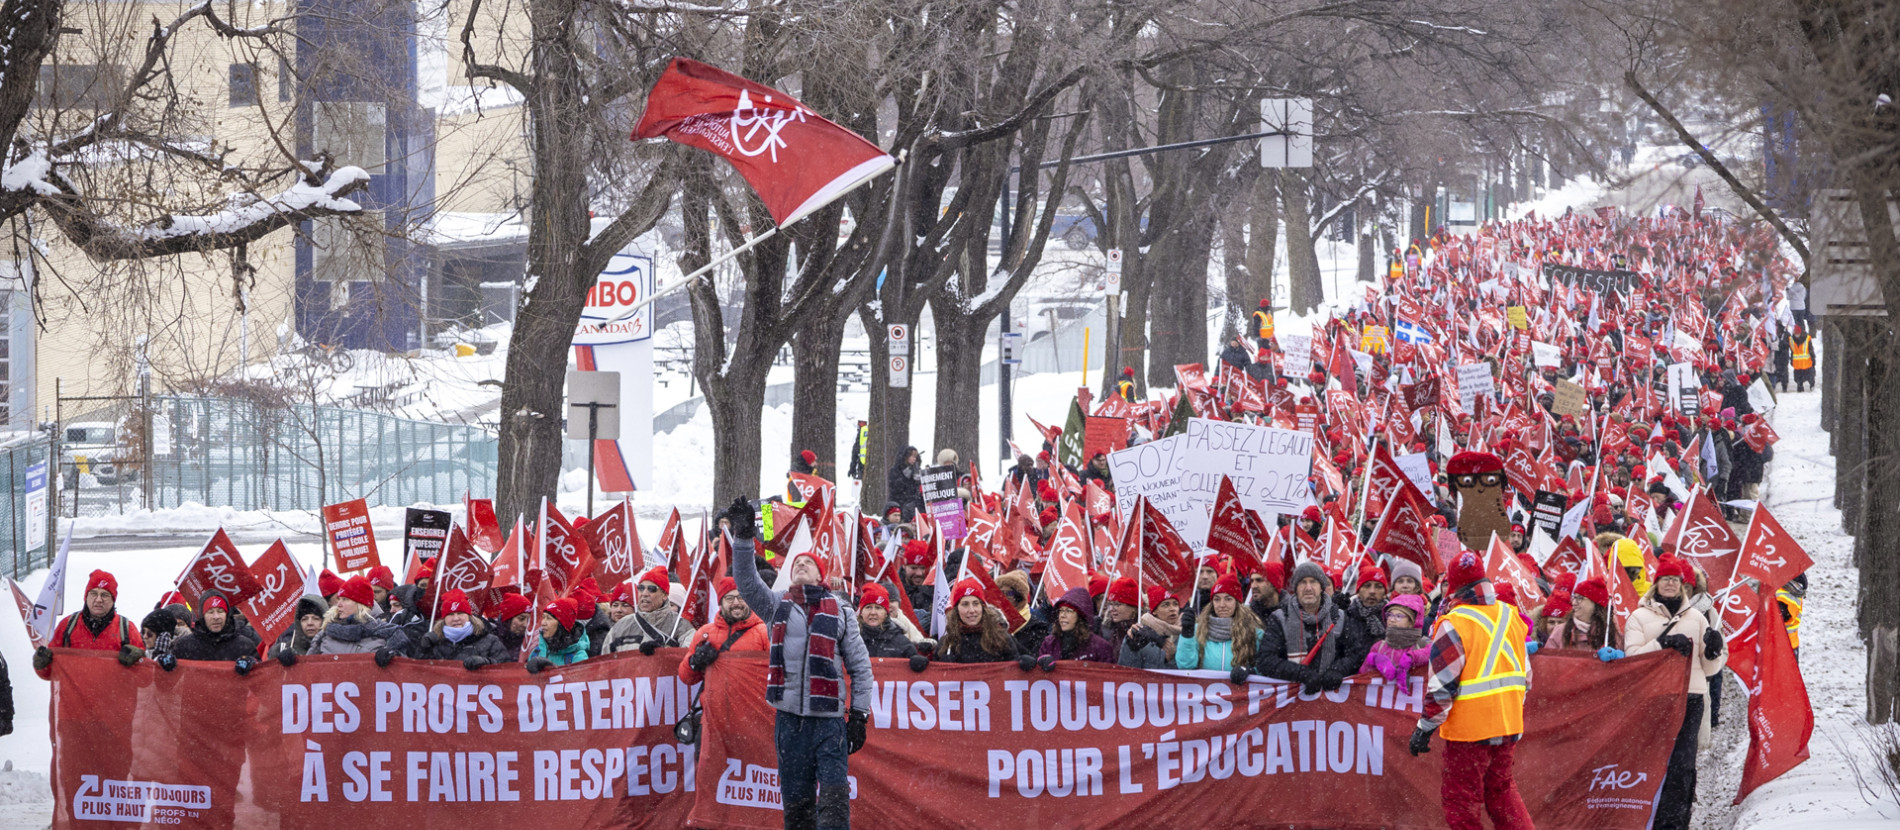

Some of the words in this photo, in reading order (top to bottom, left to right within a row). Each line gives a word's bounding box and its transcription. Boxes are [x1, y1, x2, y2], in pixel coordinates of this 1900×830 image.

[1187, 420, 1256, 454] PASSEZ
[1259, 431, 1313, 457] LEGAULT
[1111, 436, 1179, 484] 50%
[1234, 454, 1258, 471] ET
[1117, 485, 1138, 498] DES
[1180, 470, 1256, 497] COLLETEZ
[1180, 501, 1194, 512] LA
[351, 515, 368, 526] POUR
[335, 526, 366, 539] PROTÉGER
[410, 527, 446, 538] ENSEIGNER
[336, 540, 350, 550] MON
[261, 601, 288, 627] Fédération
[265, 623, 275, 632] de
[281, 681, 361, 734] DES
[375, 681, 504, 734] PROFS
[516, 674, 704, 733] DÉTERMI
[870, 680, 991, 732] VISER
[1004, 679, 1234, 731] TOUJOURS
[987, 747, 1104, 799] POUR
[1118, 719, 1385, 795] L'ÉDUCATION
[300, 738, 330, 803] À
[341, 751, 393, 802] SE
[406, 751, 520, 802] FAIRE
[751, 769, 781, 787] VISE
[108, 784, 142, 800] VISER
[145, 786, 207, 804] TOUJOURS
[724, 785, 754, 801] PLUS
[81, 801, 112, 815] PLUS
[116, 802, 146, 818] HAUT
[153, 808, 187, 817] PROFS
[153, 815, 181, 825] NÉGO
